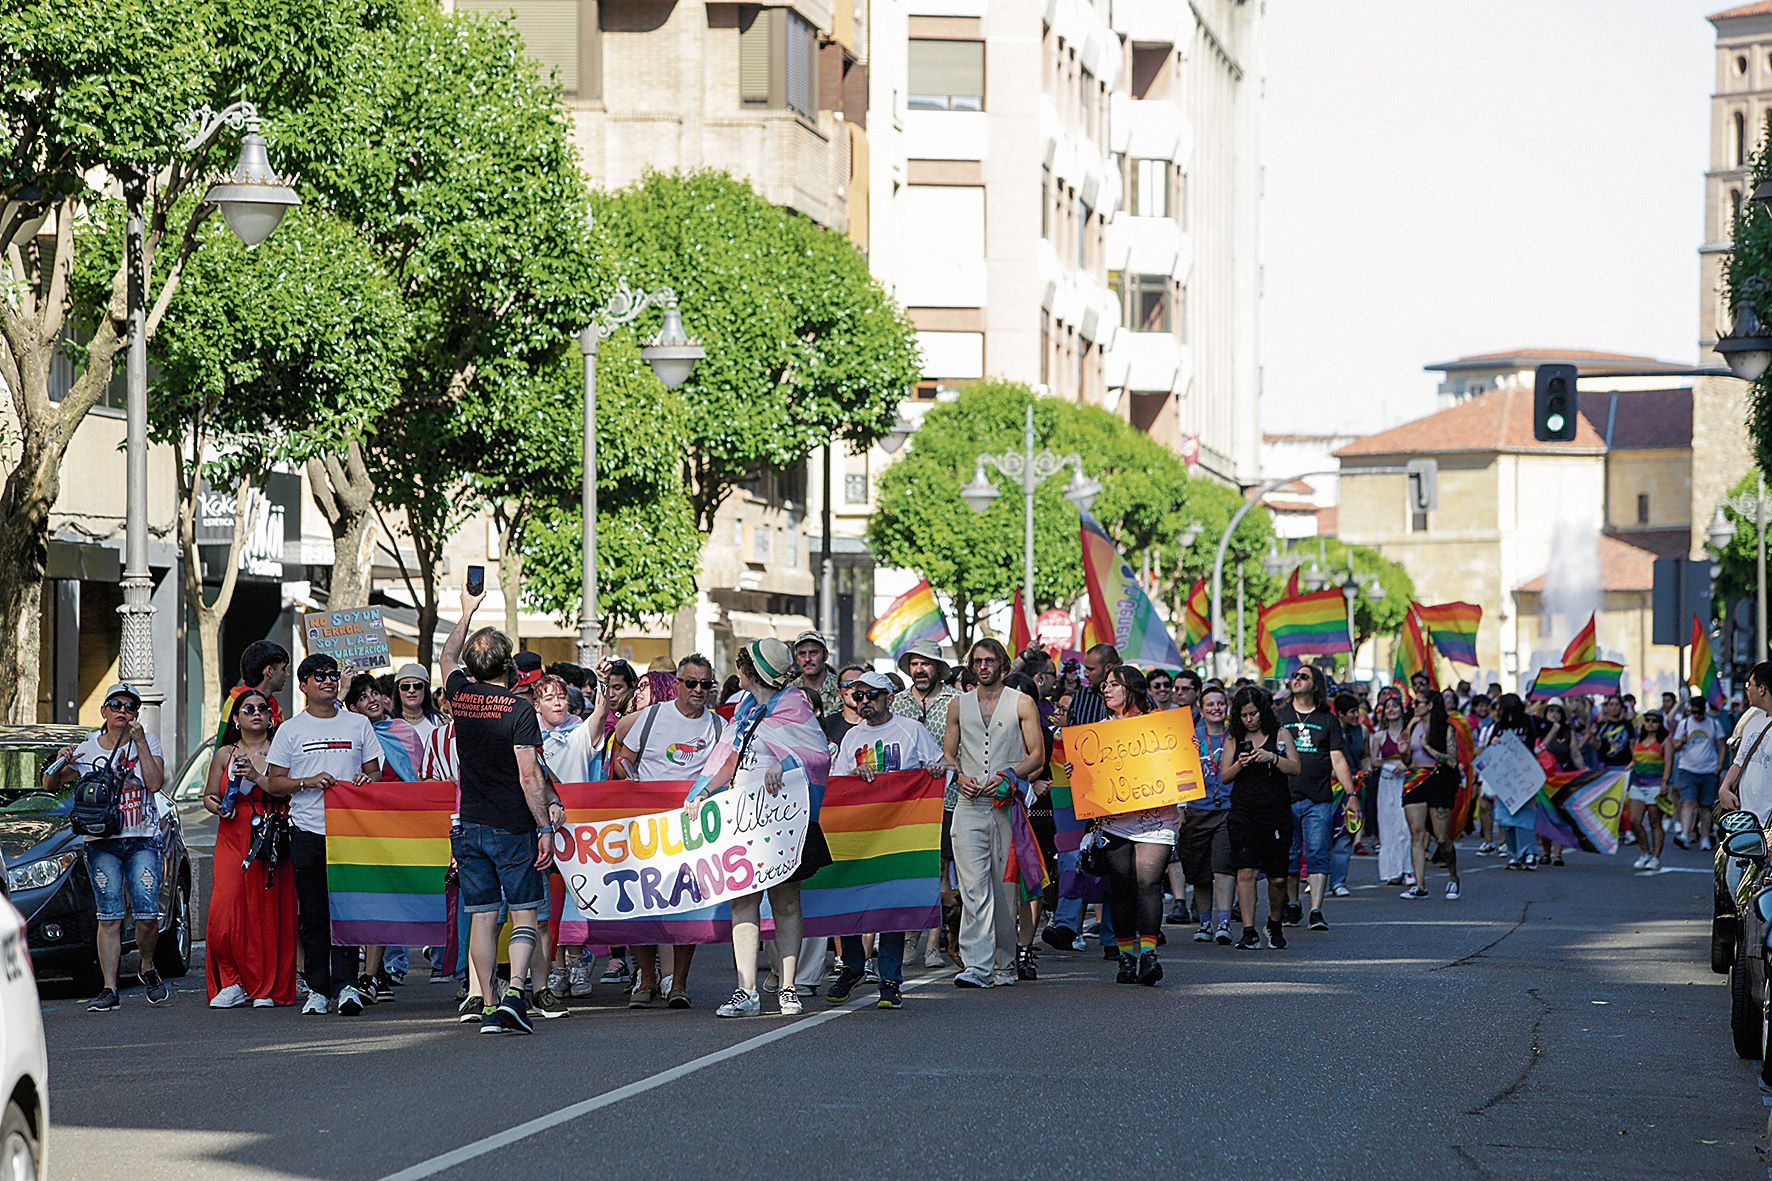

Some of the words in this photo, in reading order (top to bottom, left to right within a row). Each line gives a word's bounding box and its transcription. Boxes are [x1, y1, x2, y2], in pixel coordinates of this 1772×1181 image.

[310, 618, 328, 628] NO
[331, 611, 359, 627] SOY
[361, 609, 380, 621] UN
[316, 637, 339, 649] SOY
[462, 703, 480, 711] SHORE
[481, 704, 493, 712] SAN
[493, 705, 513, 713] DIEGO
[485, 695, 517, 706] CAMP
[553, 800, 722, 865] ORGULLO
[733, 784, 802, 836] libre
[570, 874, 600, 915] &
